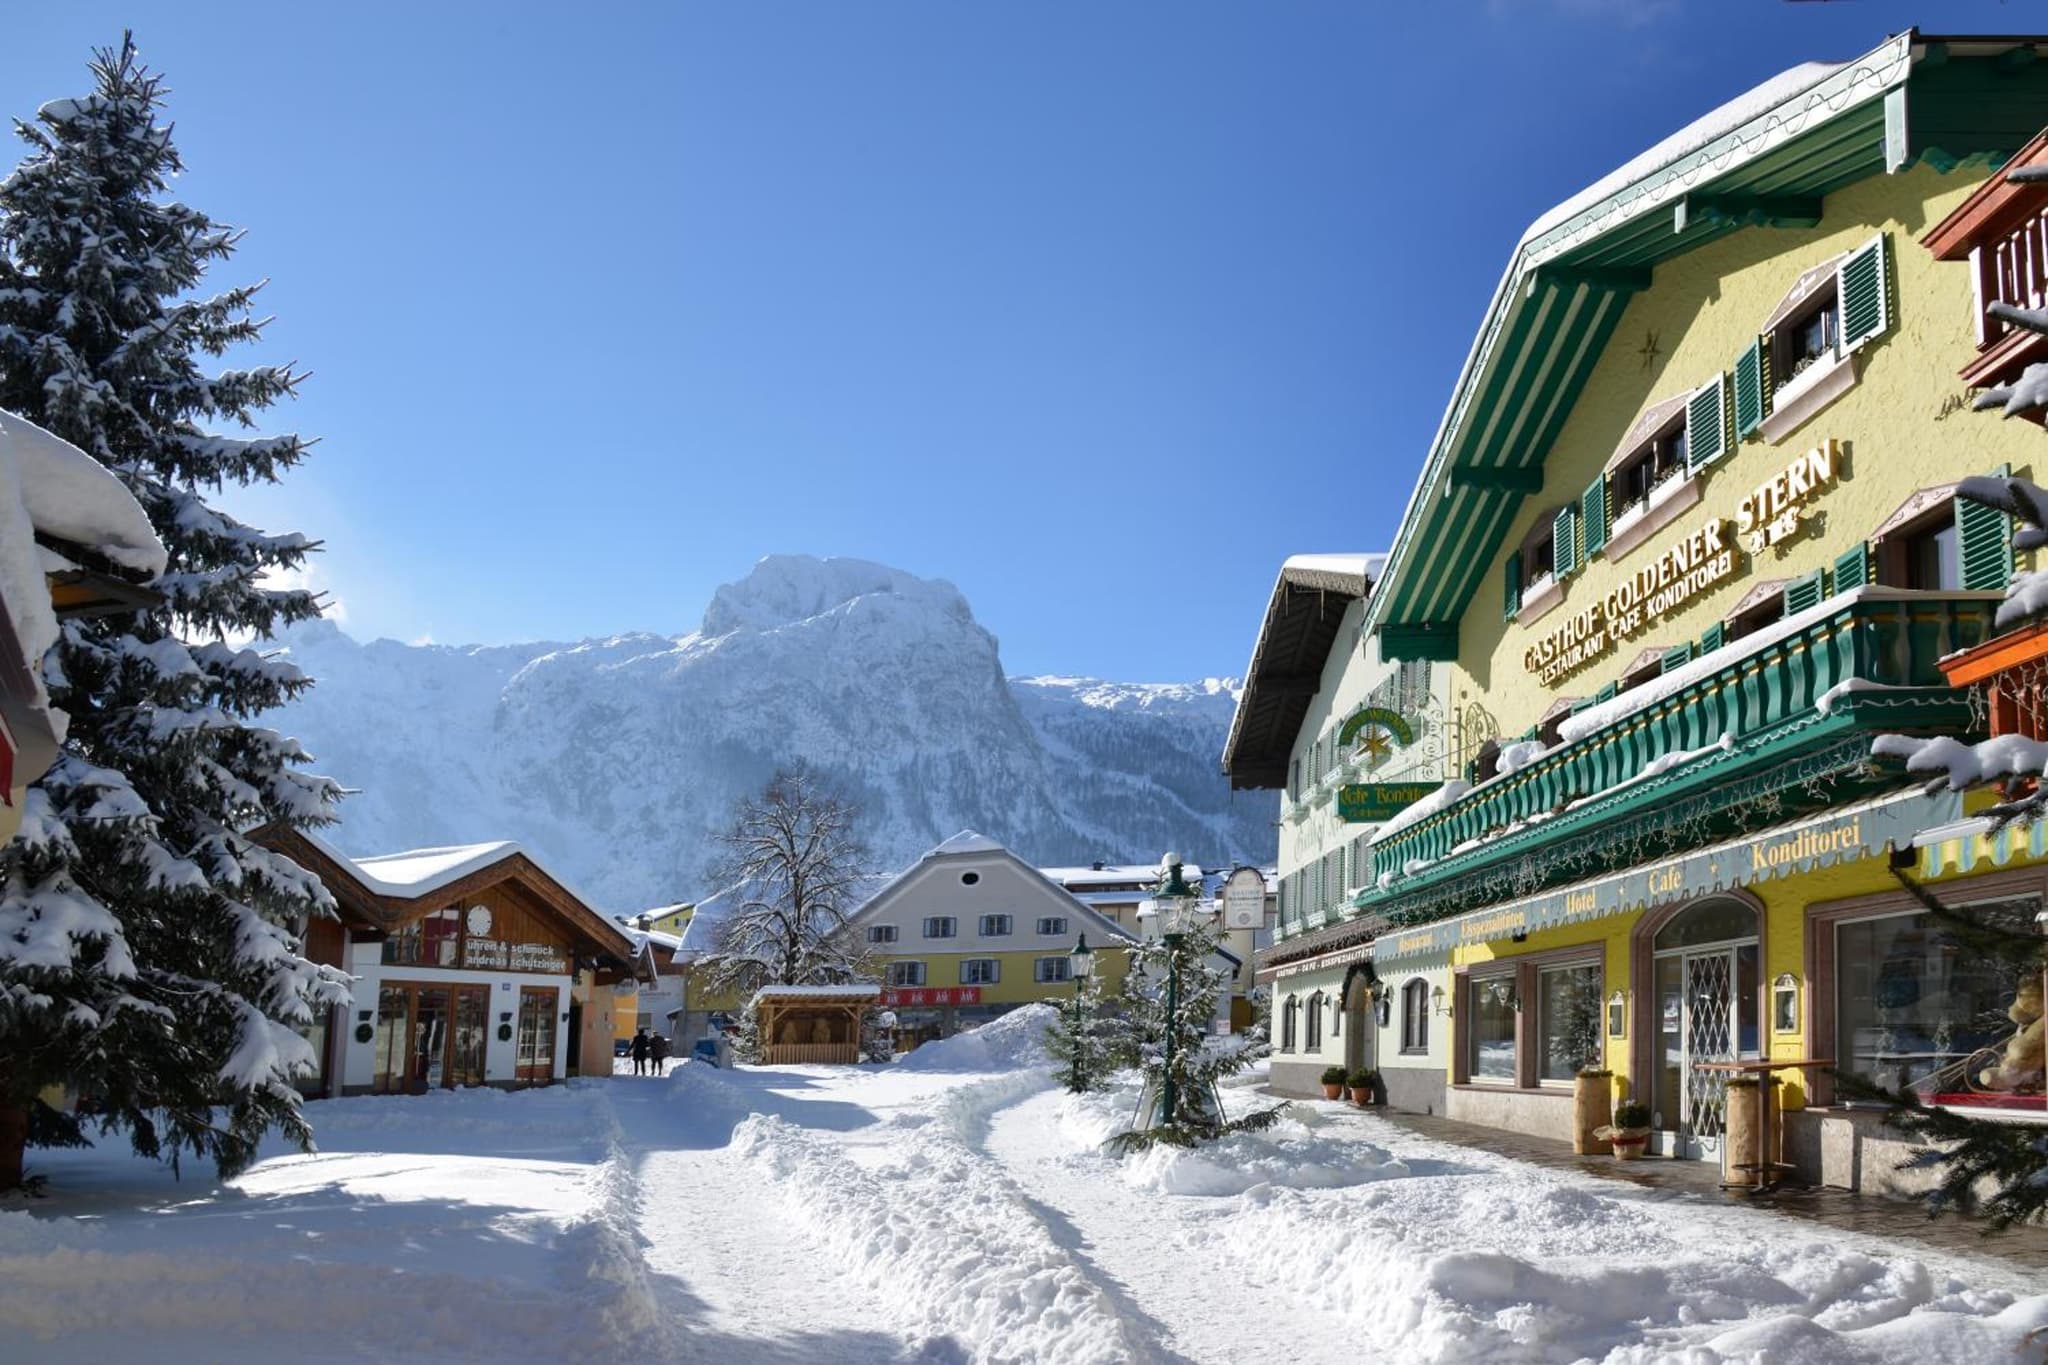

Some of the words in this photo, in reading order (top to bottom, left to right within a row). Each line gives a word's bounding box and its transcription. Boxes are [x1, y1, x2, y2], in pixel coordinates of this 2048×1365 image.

[1524, 604, 1599, 673] GASTHOF
[1603, 518, 1722, 621] GOLDENER
[1736, 439, 1832, 535] STERN
[1538, 630, 1606, 687] RESTAURANT
[1609, 606, 1641, 640] CAFE
[1647, 550, 1732, 620] KONDITOREI
[1566, 891, 1596, 915] Hotel
[1649, 868, 1682, 895] Cafe
[1752, 816, 1861, 871] Konditorei
